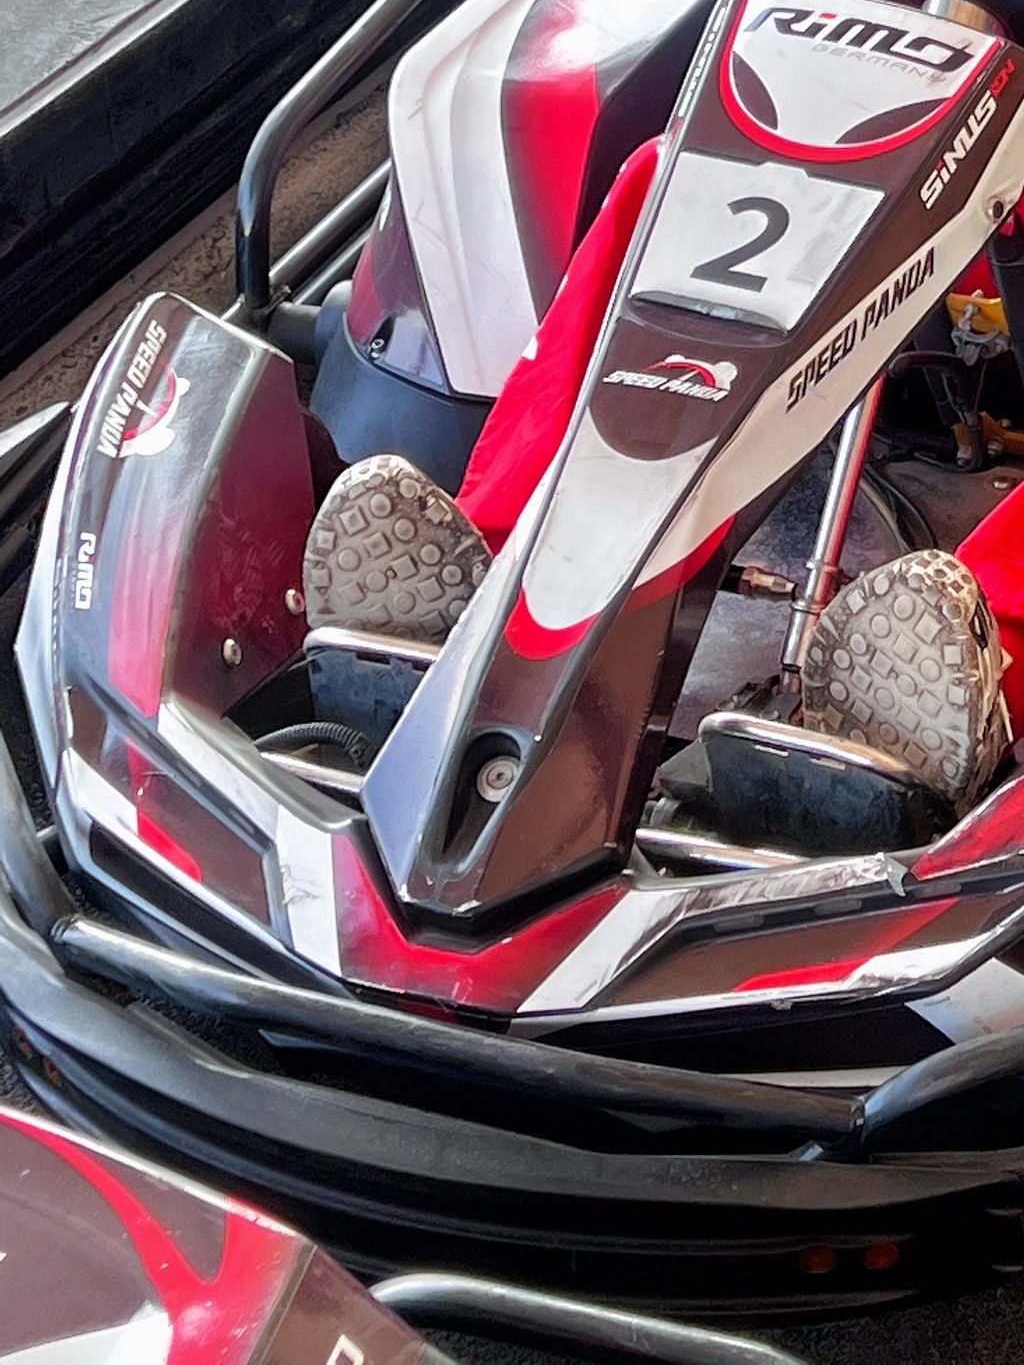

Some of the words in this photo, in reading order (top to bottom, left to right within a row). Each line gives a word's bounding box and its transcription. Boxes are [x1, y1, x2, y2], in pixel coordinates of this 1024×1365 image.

[690, 196, 791, 292] 2
[127, 319, 168, 390] SPEED
[785, 318, 858, 414] SPEED
[861, 246, 936, 343] PANDA
[97, 381, 139, 458] PANDA
